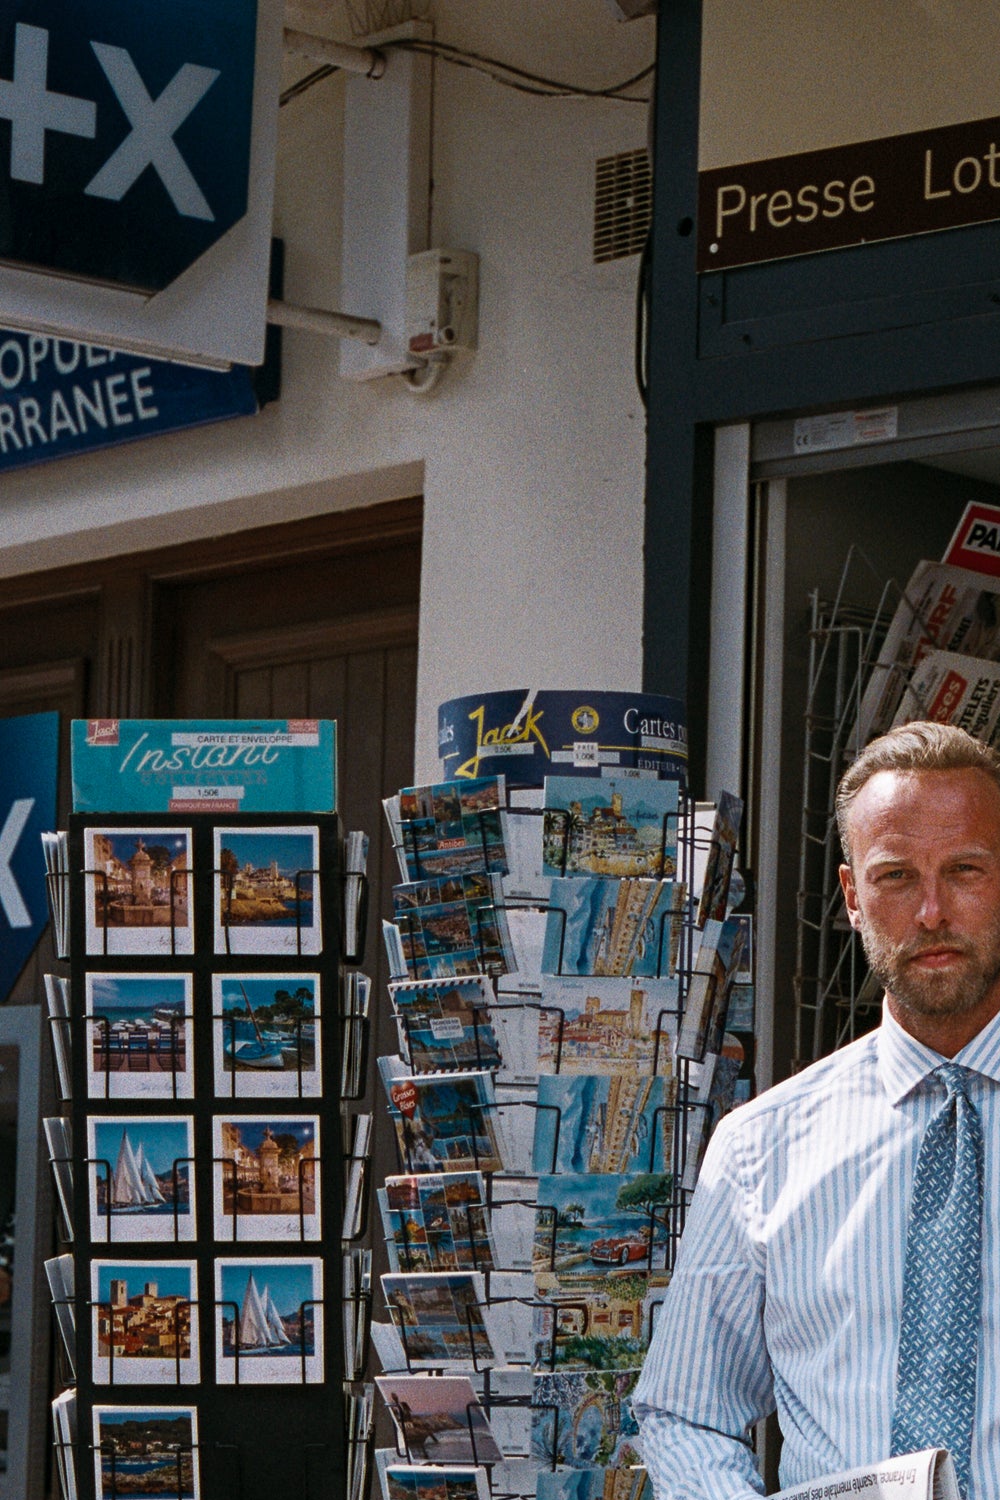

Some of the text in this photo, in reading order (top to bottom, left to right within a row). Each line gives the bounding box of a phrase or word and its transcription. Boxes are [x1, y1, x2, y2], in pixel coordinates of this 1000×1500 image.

[715, 174, 876, 238] Presse
[197, 735, 226, 744] CARTE
[228, 735, 239, 743] ET
[623, 705, 675, 747] Cartes
